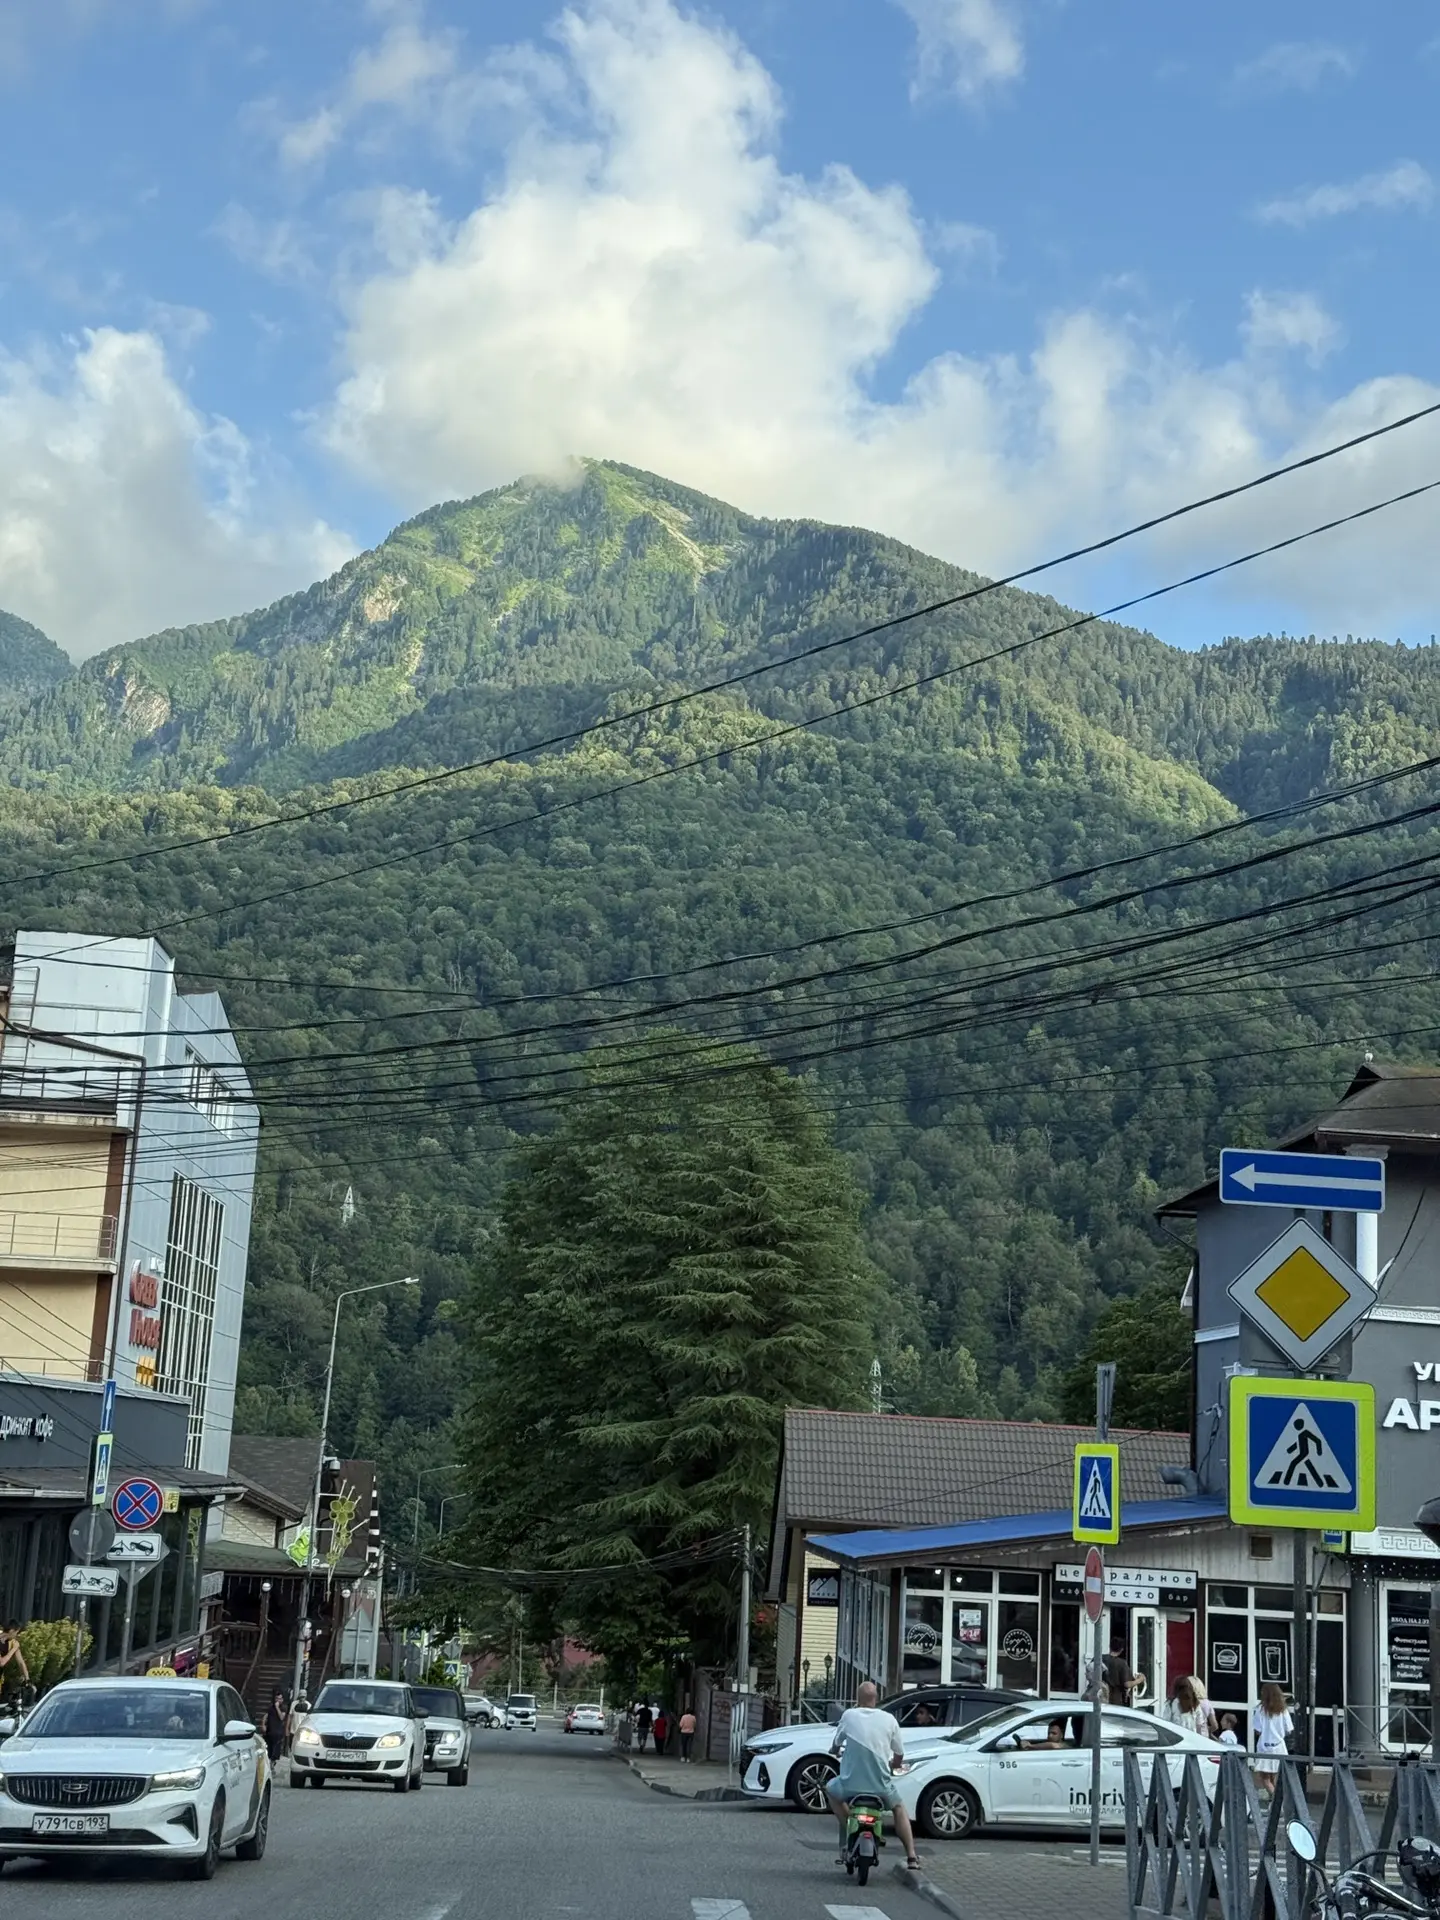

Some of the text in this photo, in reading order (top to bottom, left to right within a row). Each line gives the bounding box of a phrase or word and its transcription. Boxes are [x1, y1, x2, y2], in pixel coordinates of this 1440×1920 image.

[35, 1413, 54, 1442] кофе
[1060, 1569, 1192, 1584] церальное
[1110, 1589, 1154, 1599] есто
[1168, 1594, 1188, 1602] бар
[999, 1760, 1018, 1769] 986
[86, 1816, 105, 1827] 193
